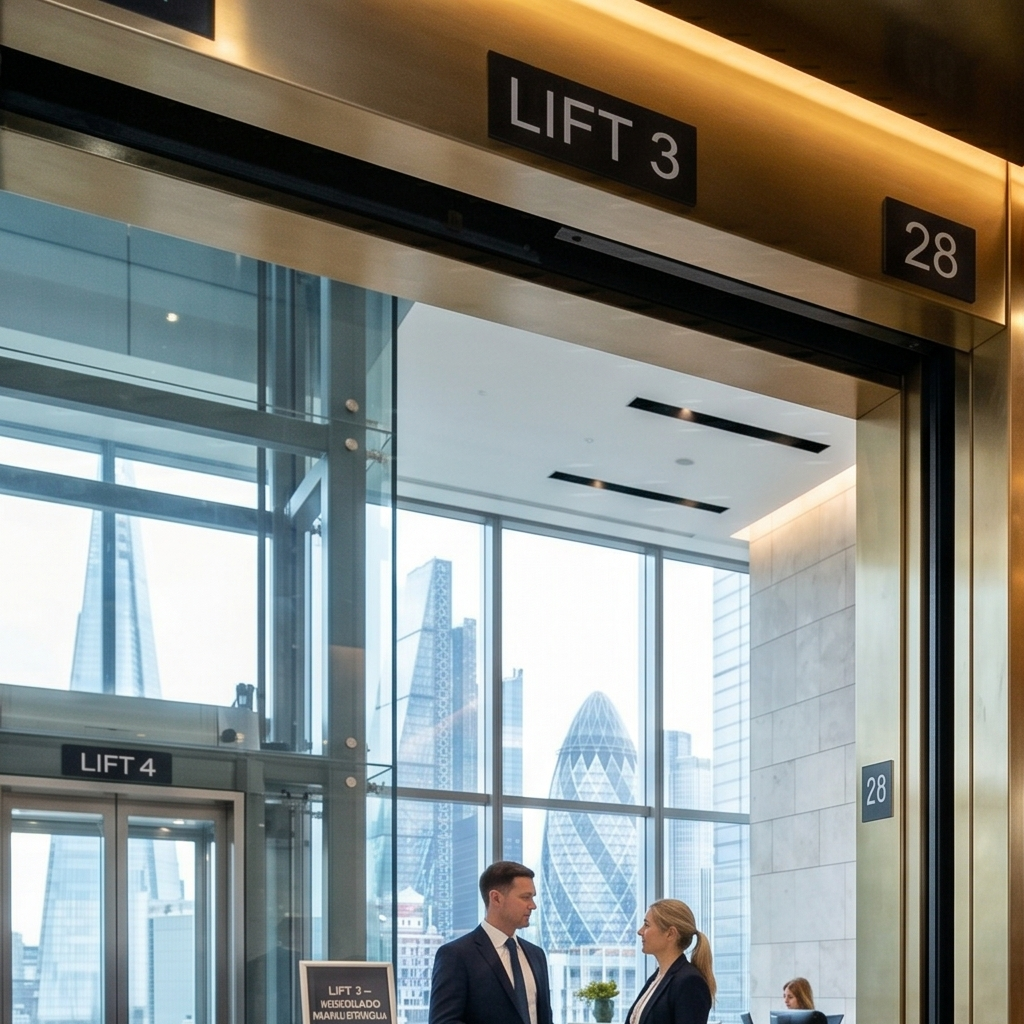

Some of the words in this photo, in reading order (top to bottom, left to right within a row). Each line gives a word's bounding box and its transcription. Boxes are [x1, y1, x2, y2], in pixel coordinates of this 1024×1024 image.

[511, 76, 633, 162] LIFT
[650, 131, 680, 180] 3
[904, 221, 958, 279] 28
[81, 752, 135, 775] LIFT
[139, 758, 156, 777] 4
[867, 774, 886, 806] 28
[328, 986, 352, 996] LIFT
[355, 986, 362, 996] 3
